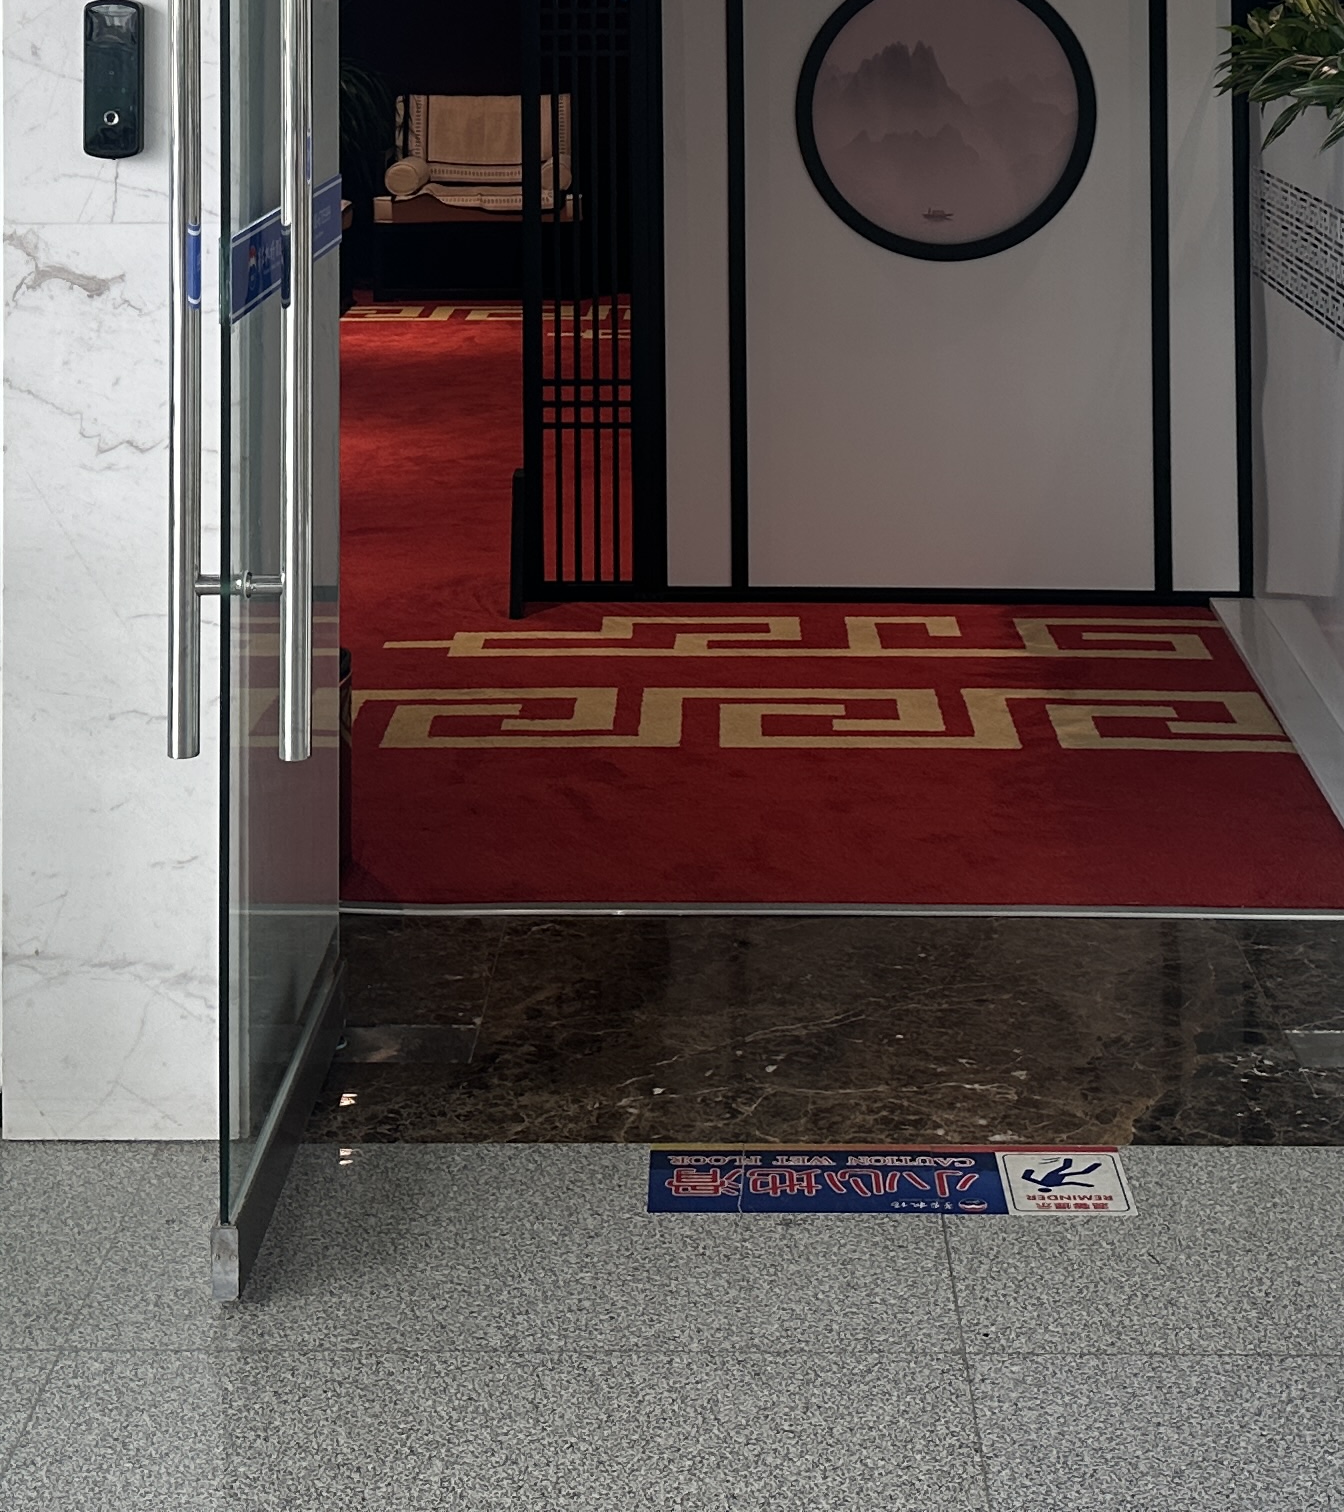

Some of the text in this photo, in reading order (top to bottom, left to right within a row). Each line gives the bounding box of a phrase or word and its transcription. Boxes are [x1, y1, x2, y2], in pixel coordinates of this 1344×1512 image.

[667, 1155, 976, 1167] CAUTION WET FLOOR
[664, 1167, 980, 1198] 小心地滑
[1025, 1194, 1114, 1202] REMINDER
